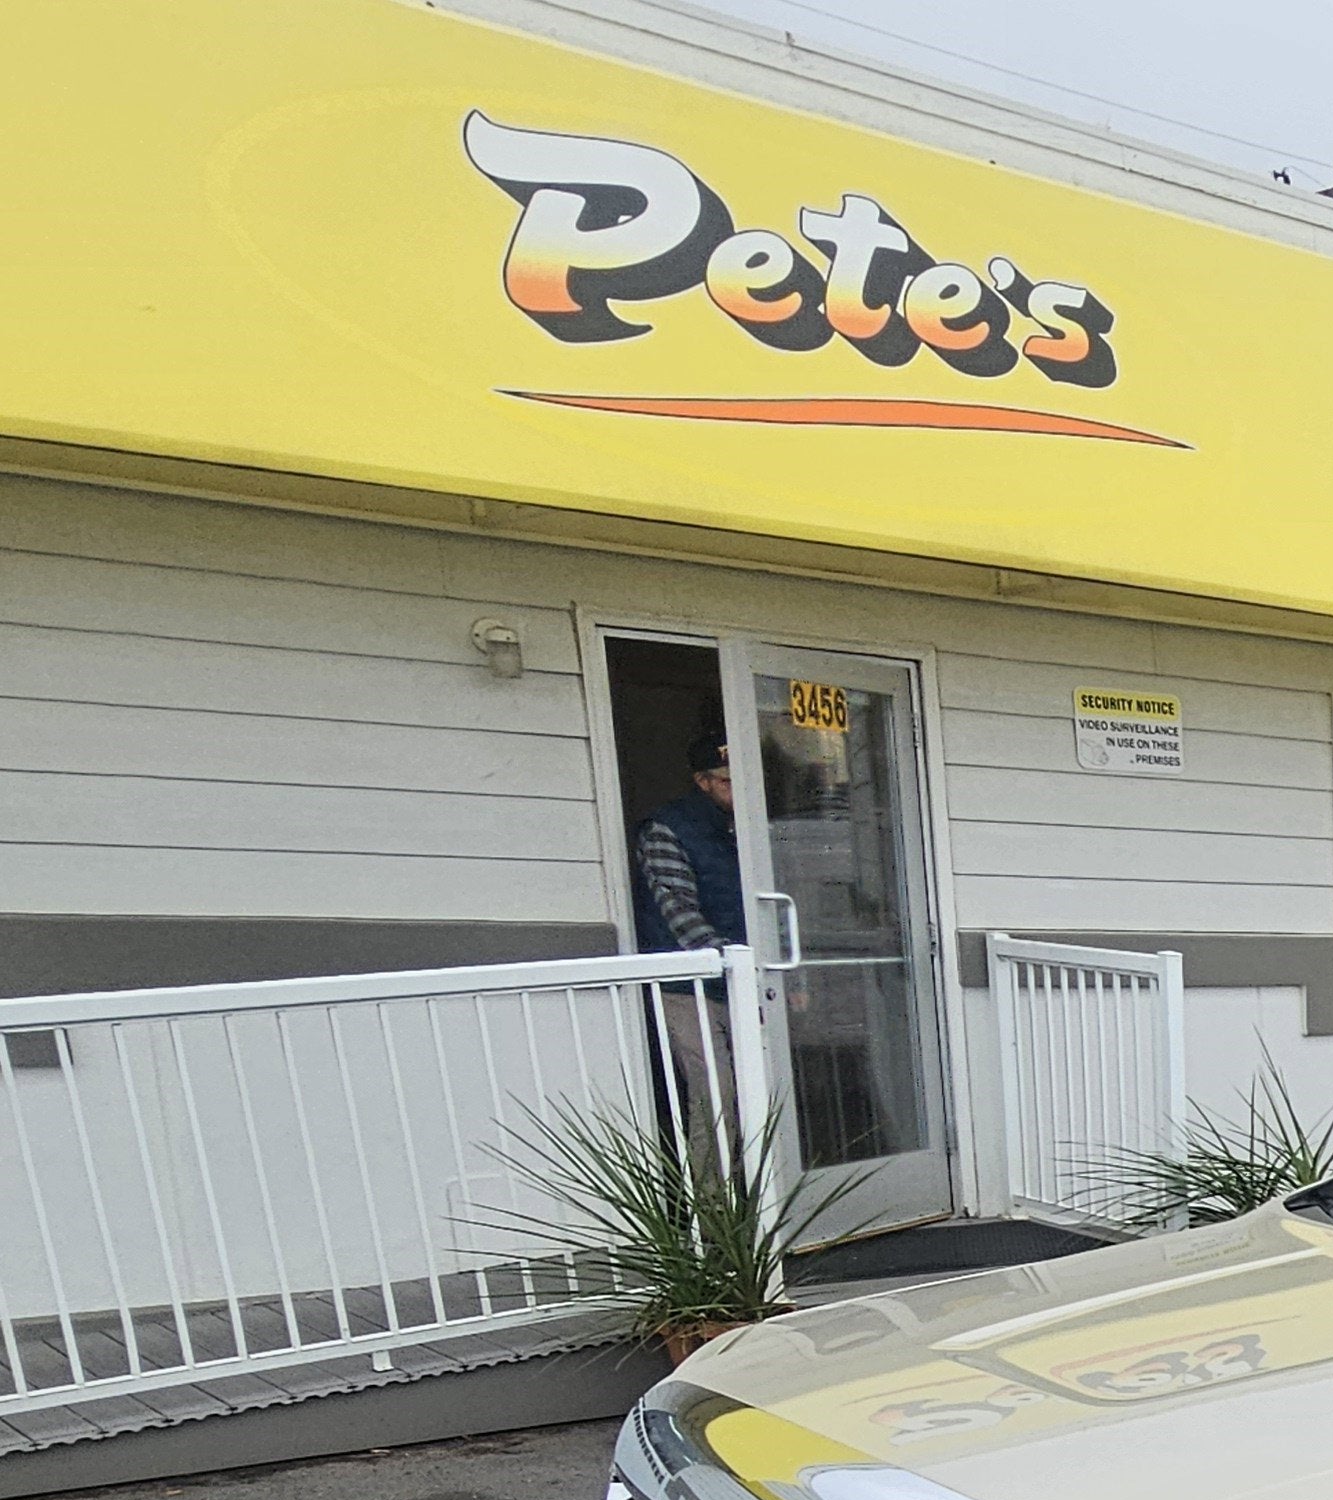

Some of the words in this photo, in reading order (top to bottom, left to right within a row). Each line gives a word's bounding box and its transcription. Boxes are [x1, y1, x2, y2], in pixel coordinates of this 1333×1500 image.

[463, 109, 1112, 382] Pete's
[792, 682, 847, 729] 3456
[1080, 694, 1133, 712] SECURITY
[1136, 699, 1175, 716] NOTICE
[1078, 719, 1109, 731] VIDEO
[1110, 721, 1179, 737] SURVEILLANCE
[1105, 737, 1116, 747] IN
[1117, 738, 1135, 749] USE
[1136, 739, 1150, 750] ON
[1152, 740, 1180, 752] THESE
[1134, 753, 1182, 767] PREMISES
